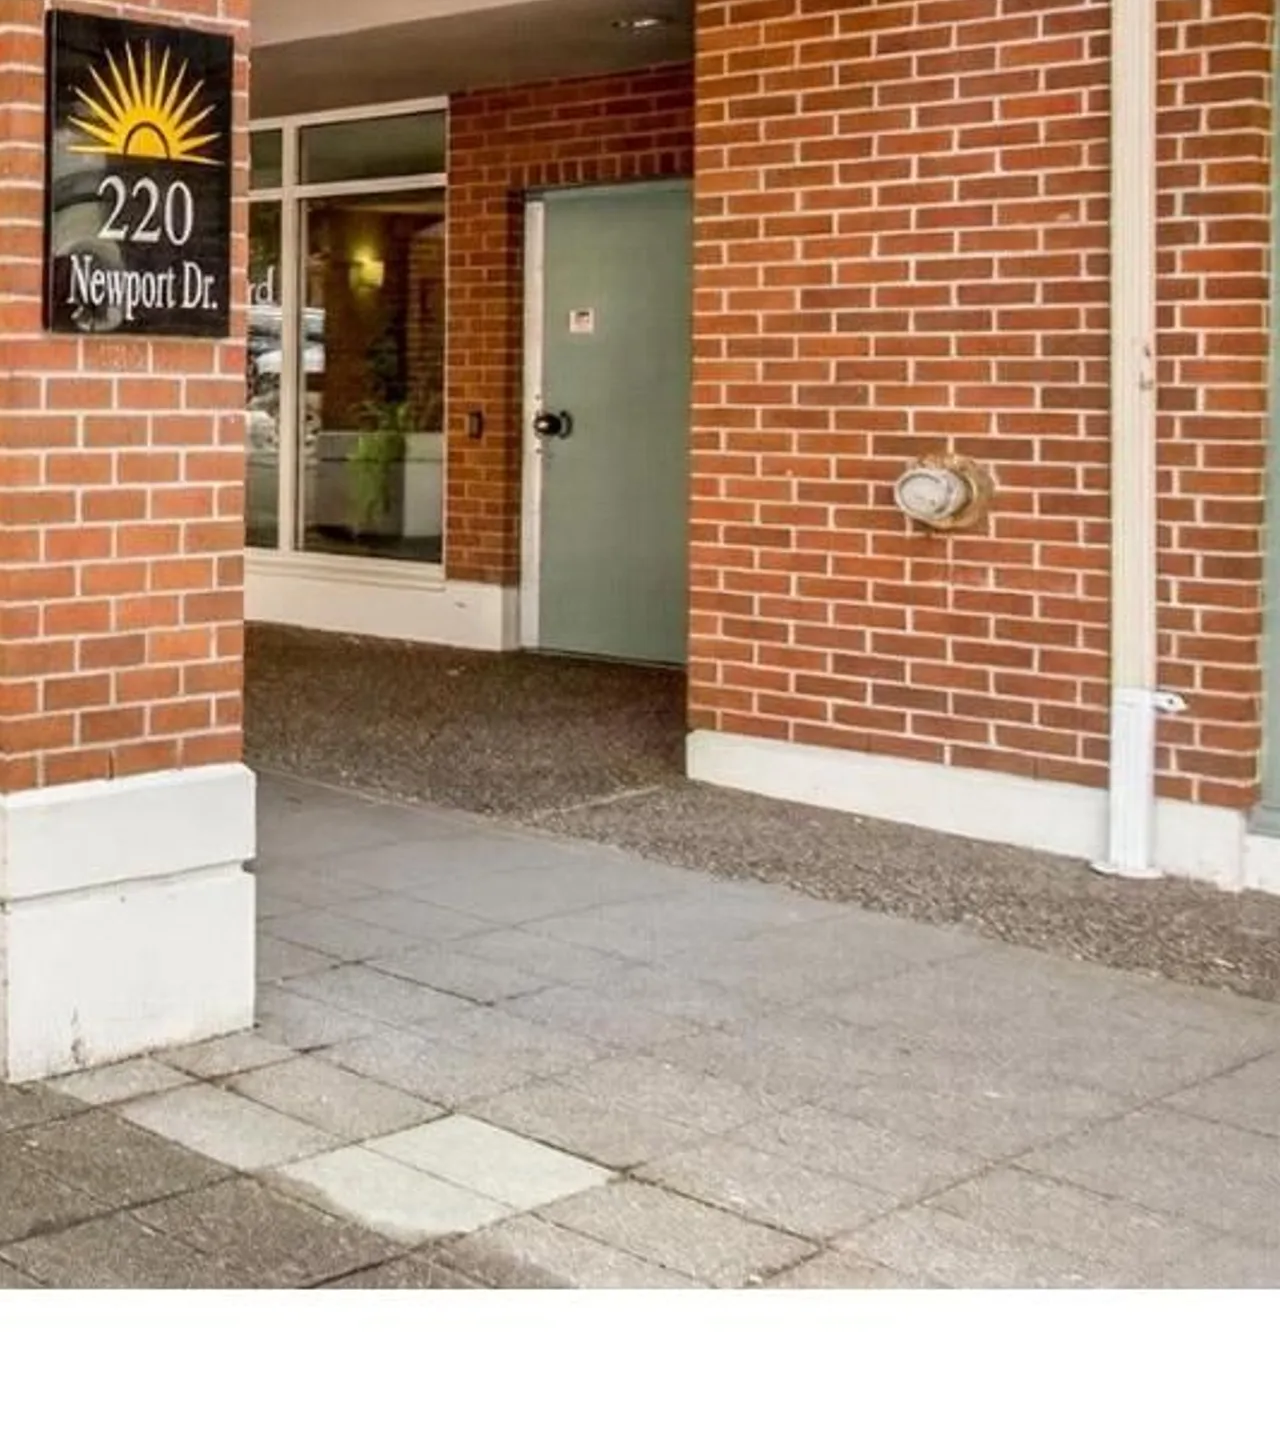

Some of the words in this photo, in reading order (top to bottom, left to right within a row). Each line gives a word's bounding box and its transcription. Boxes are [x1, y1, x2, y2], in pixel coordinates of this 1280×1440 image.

[96, 174, 195, 247] 220
[66, 253, 177, 322] Newport
[181, 260, 219, 310] Dr.
